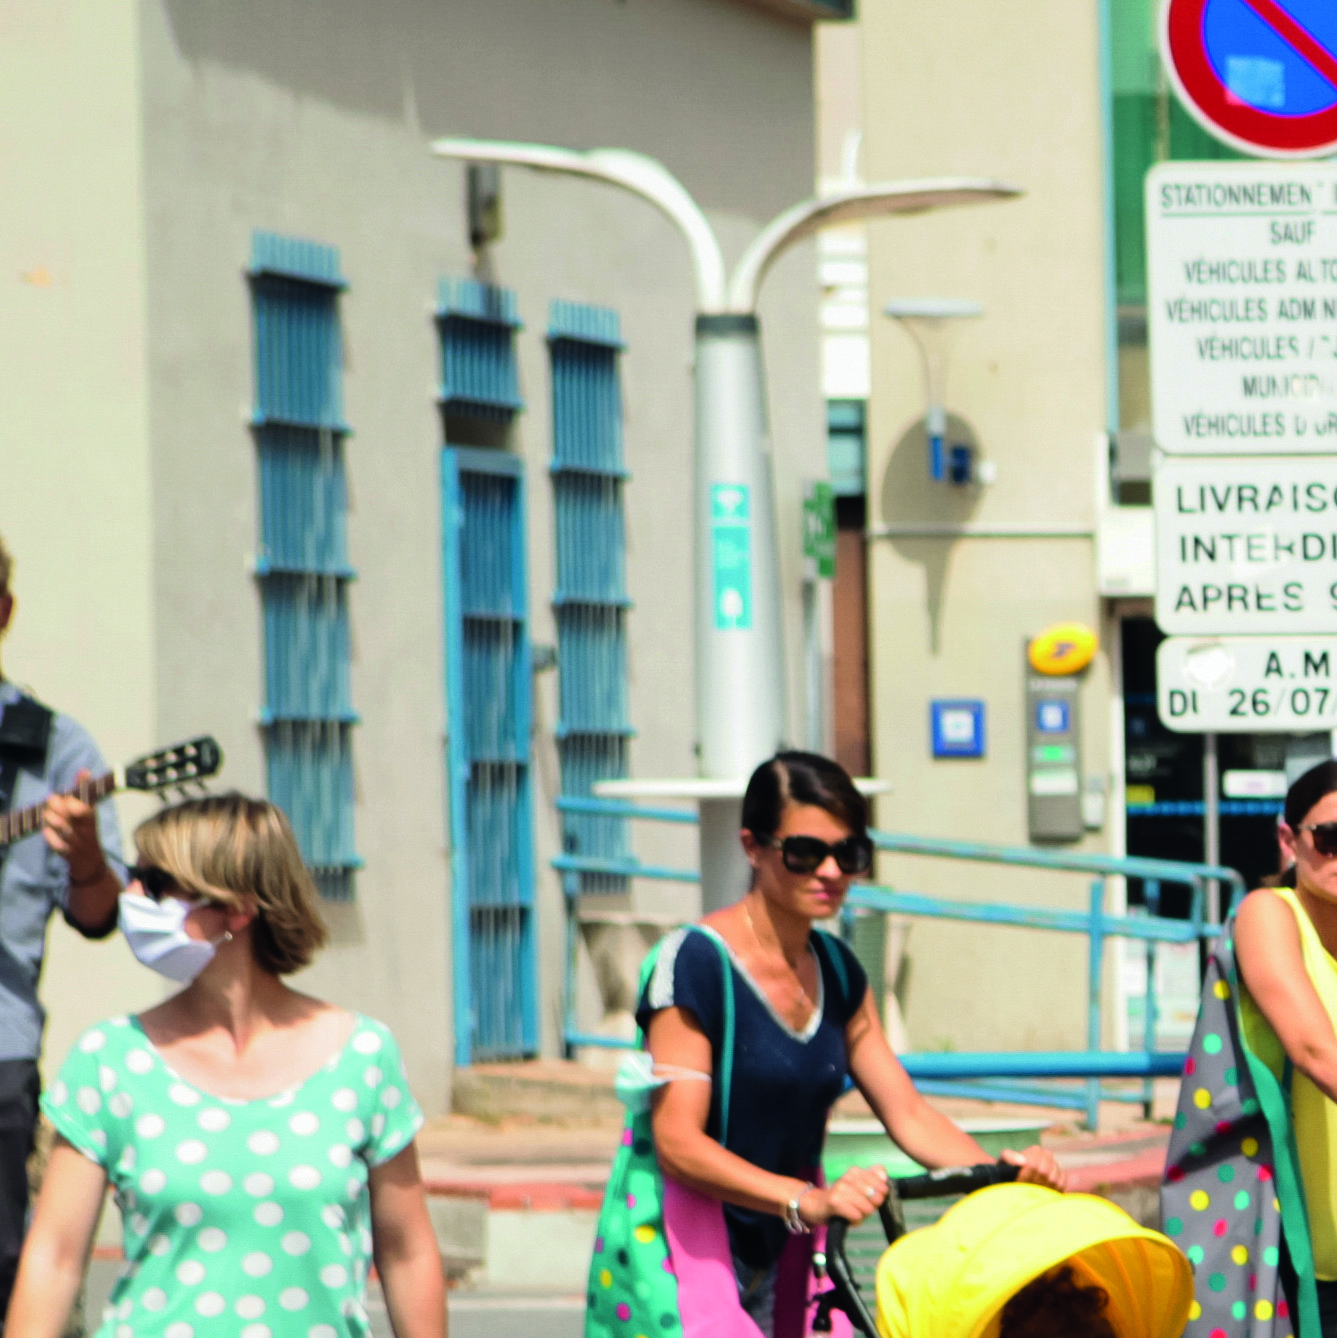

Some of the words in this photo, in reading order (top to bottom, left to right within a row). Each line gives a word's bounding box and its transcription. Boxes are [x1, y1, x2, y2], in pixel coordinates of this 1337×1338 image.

[1160, 182, 1324, 209] STATIONNEMEN
[1269, 219, 1316, 245] SAUF
[1184, 255, 1287, 284] VÉHICULES
[1166, 293, 1269, 323] VÉHICULES
[1183, 410, 1286, 438] VÉHICULES
[1174, 581, 1304, 613] APRES
